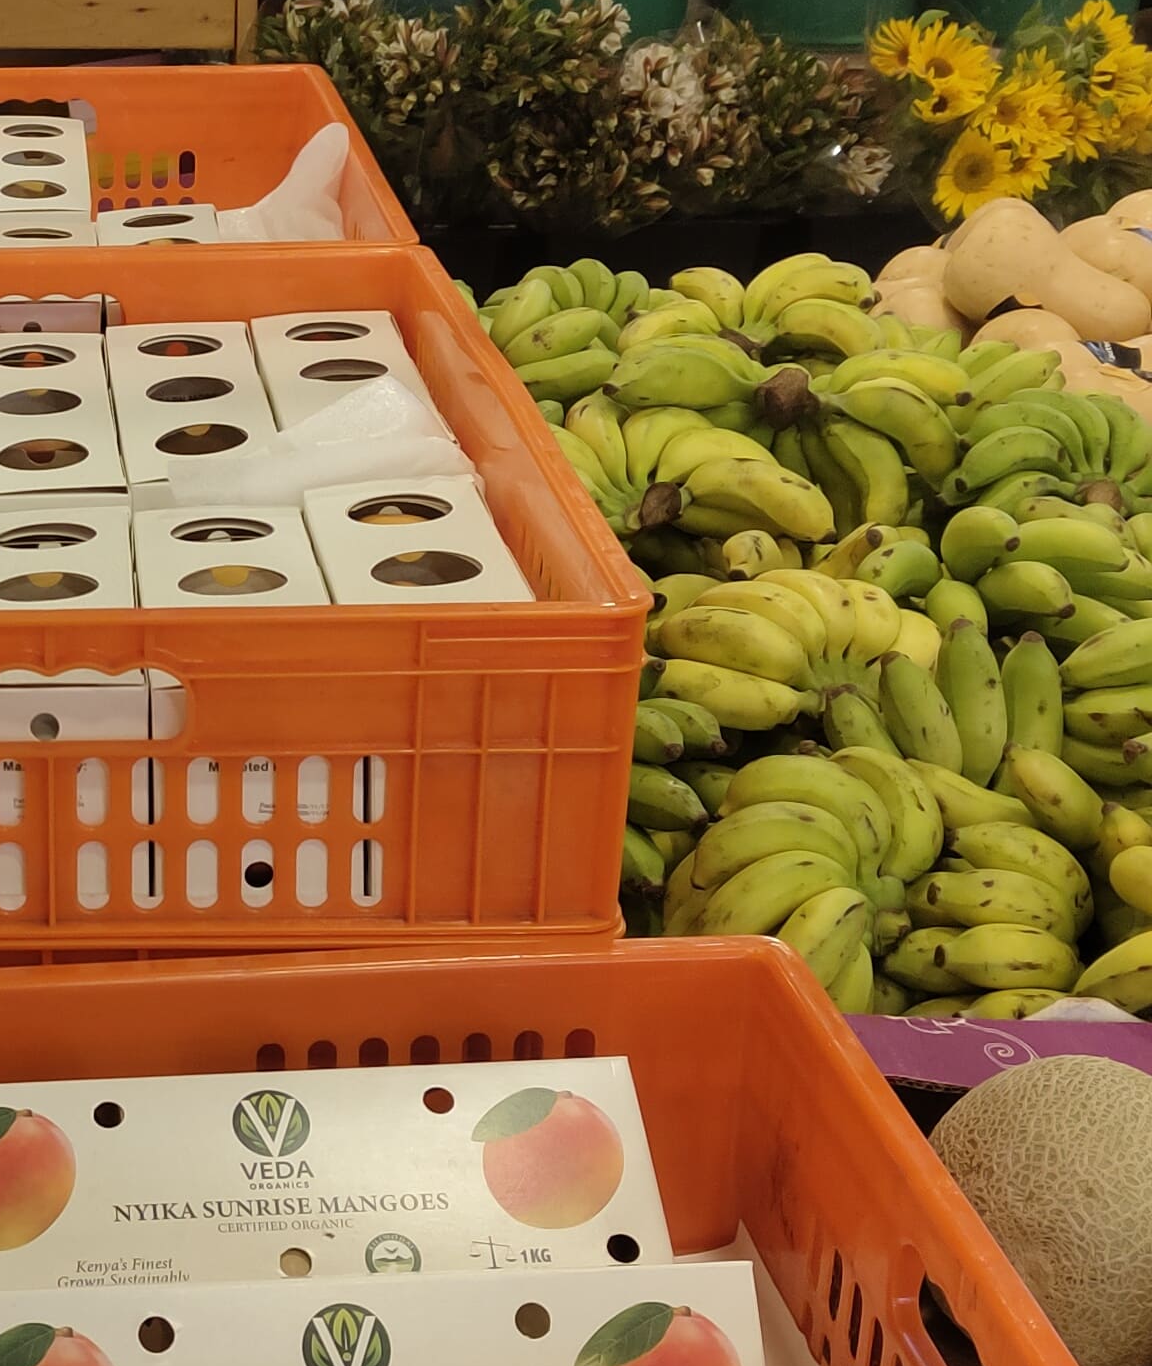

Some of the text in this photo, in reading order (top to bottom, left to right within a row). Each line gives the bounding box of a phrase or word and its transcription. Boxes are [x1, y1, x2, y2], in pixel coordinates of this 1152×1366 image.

[240, 1160, 314, 1180] VEDA
[249, 1181, 309, 1191] ORGANICS
[112, 1192, 449, 1223] NYIKA SUNRISE MANGOES
[218, 1218, 354, 1234] CERTIFIED ORGANIC
[76, 1257, 173, 1275] Kenya's Finest
[57, 1275, 105, 1288] Grown
